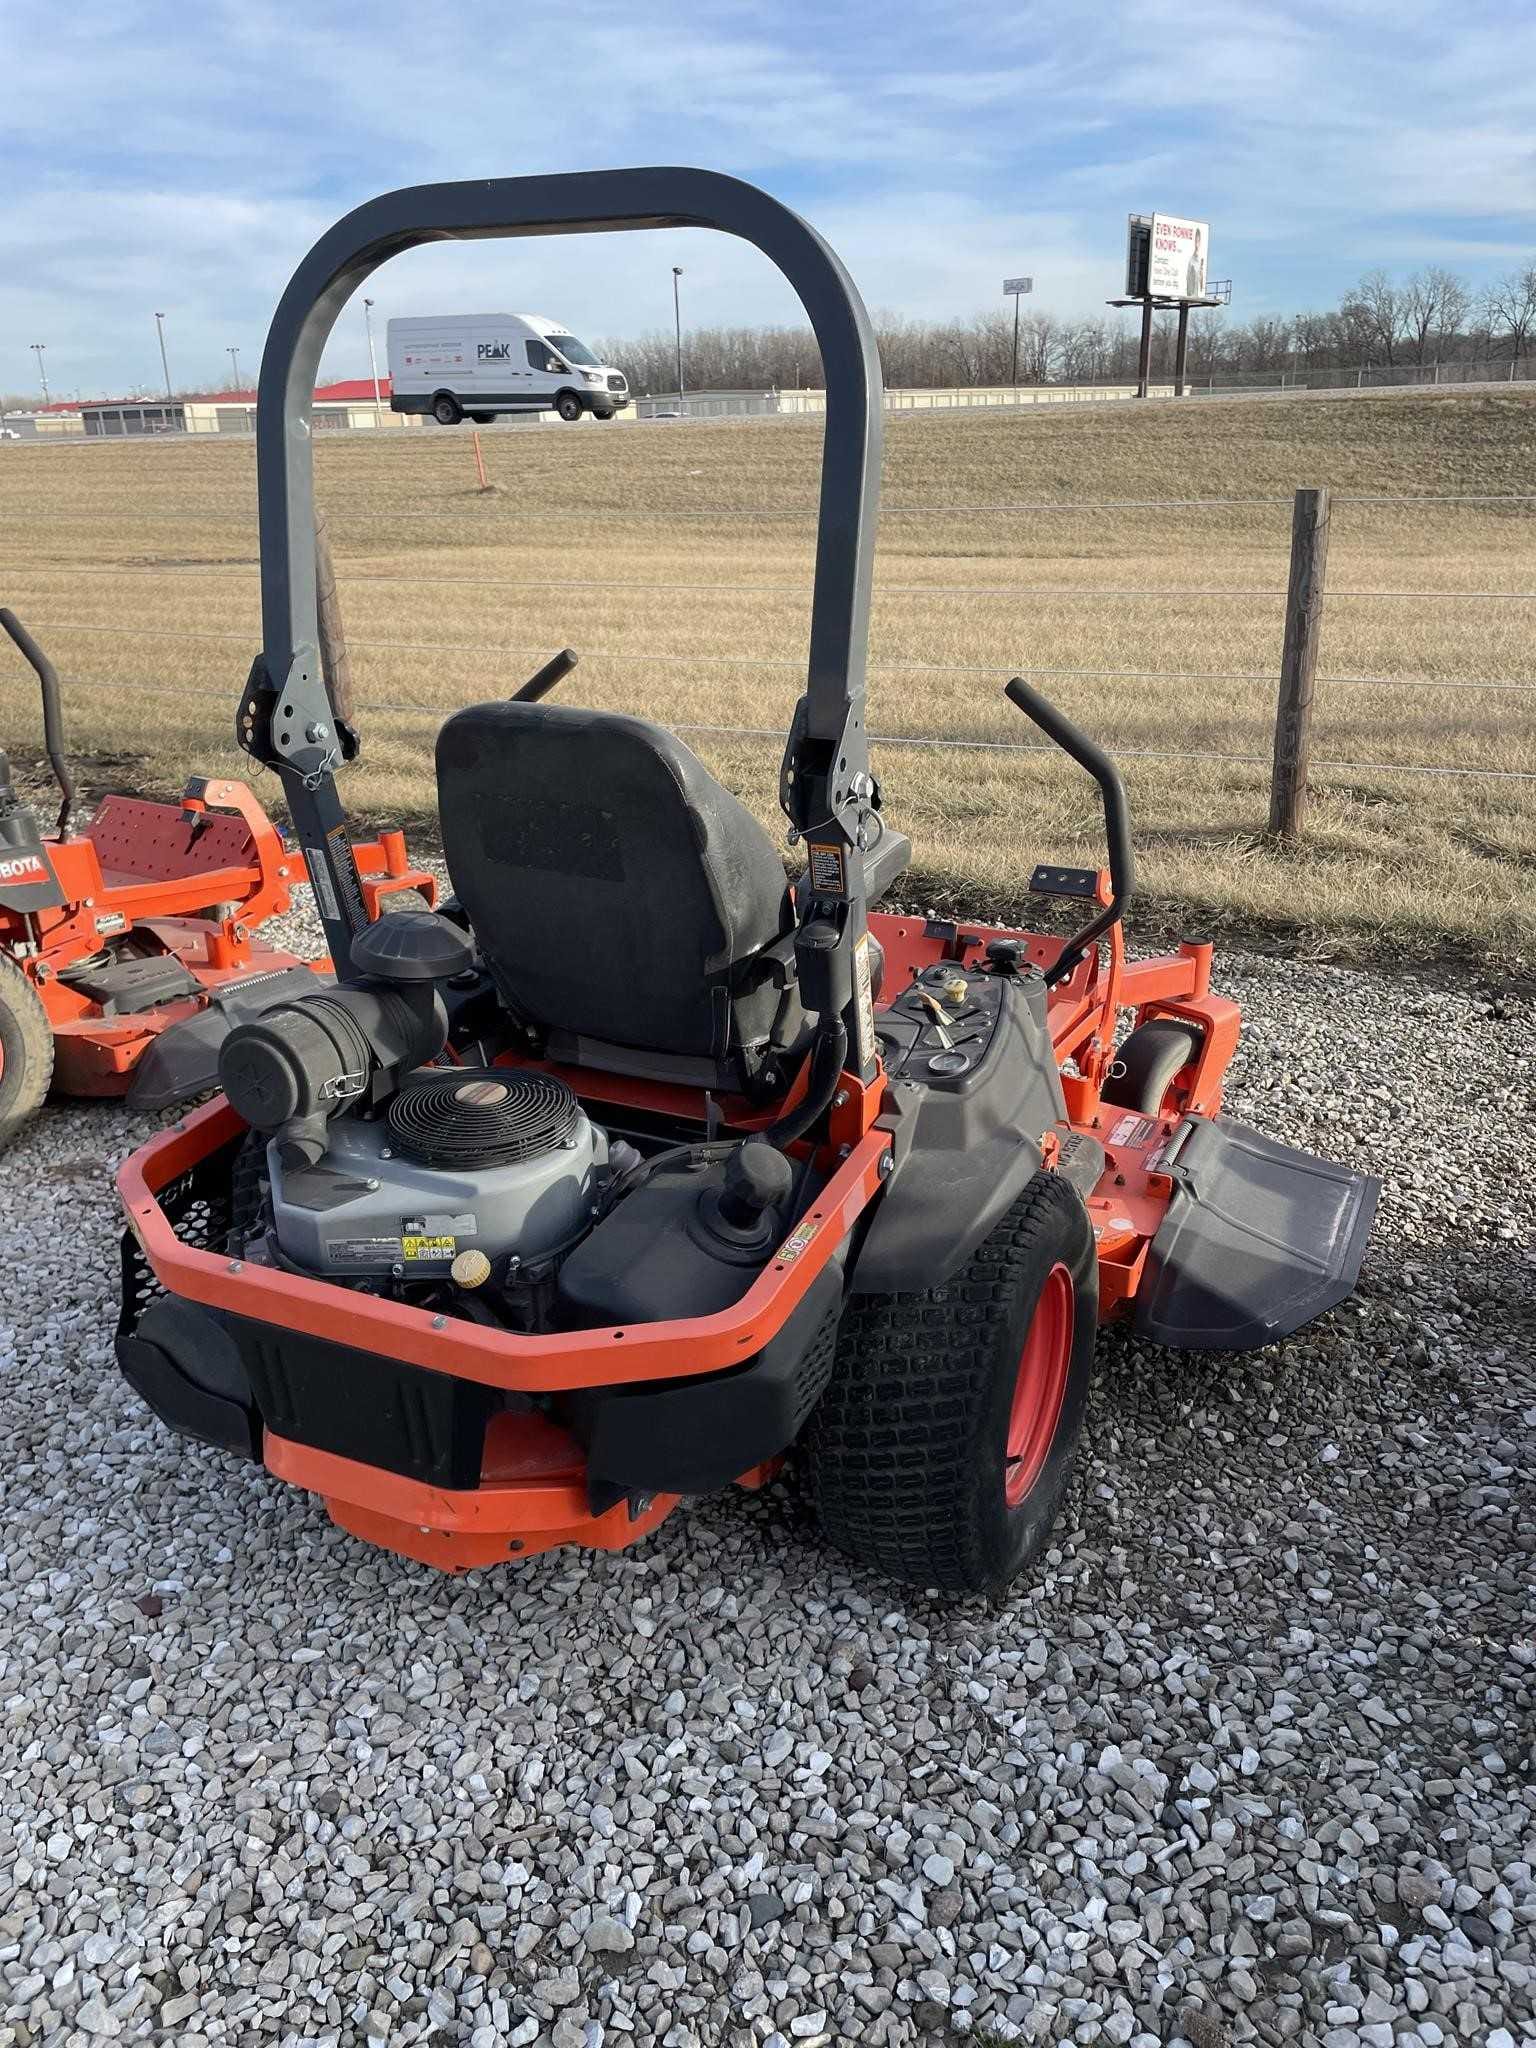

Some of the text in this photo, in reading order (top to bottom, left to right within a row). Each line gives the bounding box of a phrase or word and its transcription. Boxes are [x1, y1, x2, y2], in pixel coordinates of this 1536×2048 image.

[1157, 222, 1172, 236] EVEN
[477, 343, 510, 358] PEAK
[0, 855, 41, 879] BOTA
